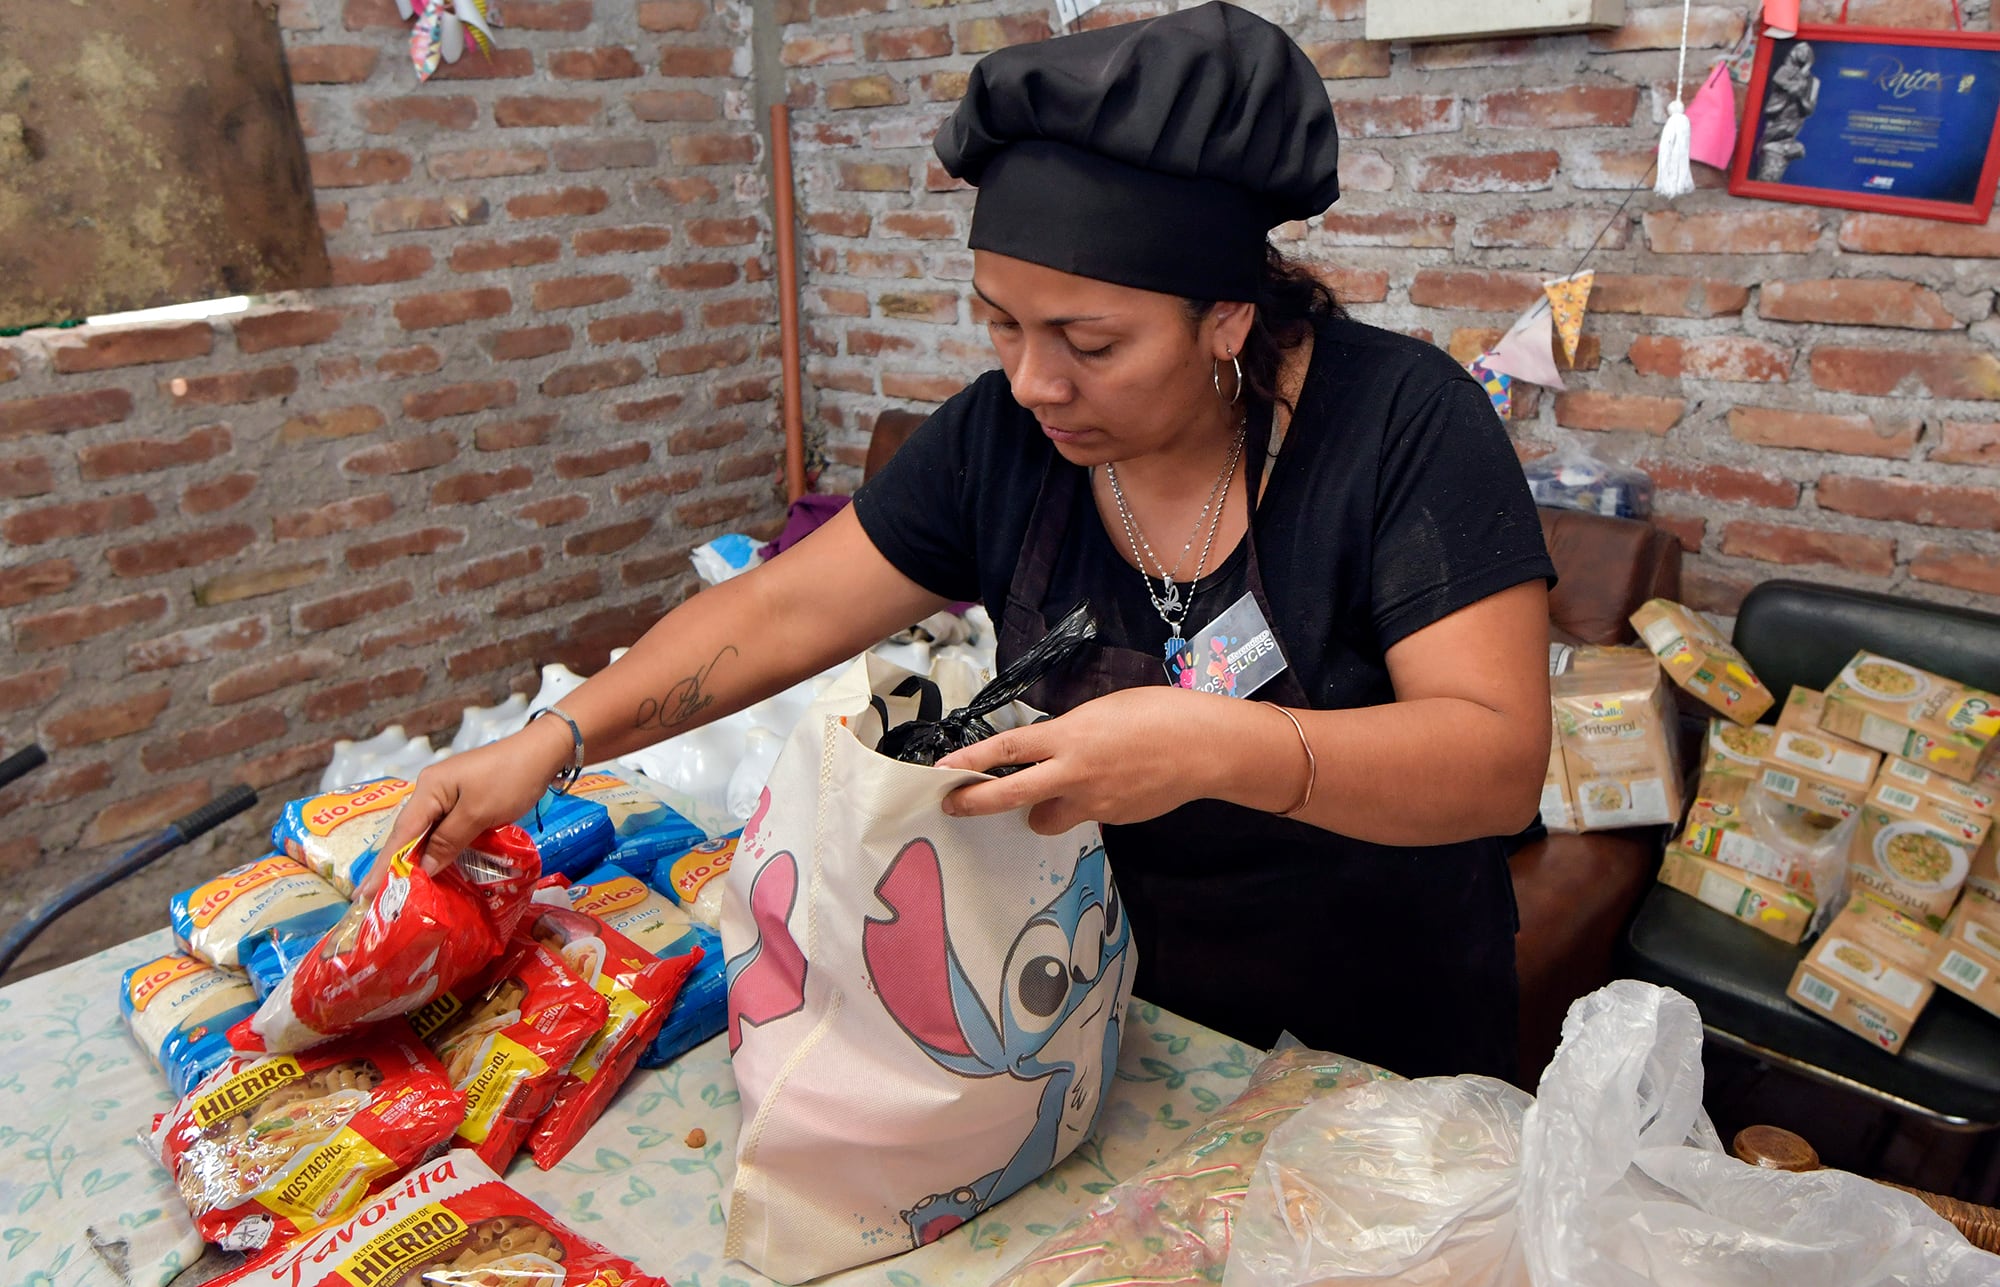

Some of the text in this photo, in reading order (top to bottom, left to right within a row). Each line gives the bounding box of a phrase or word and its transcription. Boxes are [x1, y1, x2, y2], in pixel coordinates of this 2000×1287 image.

[1223, 637, 1275, 680] FELICES
[1584, 720, 1637, 736] Integral
[1949, 698, 1990, 730] Gallo
[351, 780, 409, 807] carlo
[234, 861, 299, 888] carlo
[1855, 871, 1932, 914] Integral
[630, 908, 661, 924] FINO
[171, 976, 224, 1007] LARGO
[224, 1062, 268, 1087] CONTENIDO
[198, 1063, 298, 1122] HIERRO
[271, 1160, 458, 1287] Favorita
[353, 1207, 431, 1262] ALTO CONTENIDO DE
[350, 1211, 458, 1286] HIERRO
